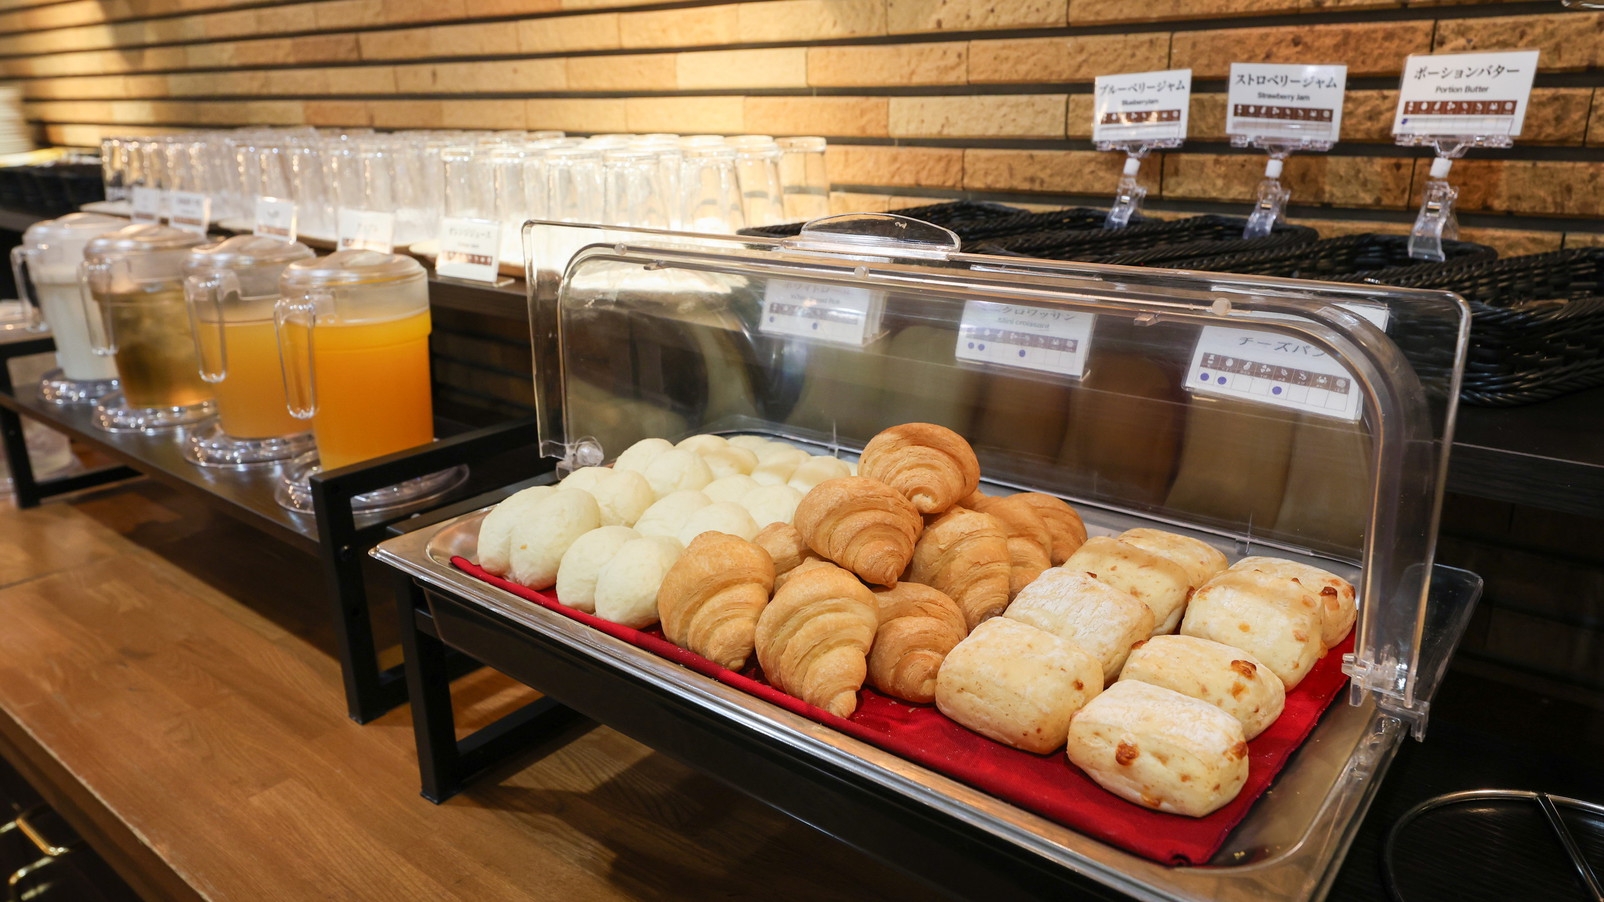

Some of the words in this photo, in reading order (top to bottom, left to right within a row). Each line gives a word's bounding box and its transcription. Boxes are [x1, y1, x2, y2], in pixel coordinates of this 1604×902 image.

[1414, 64, 1520, 80] ポーションバター
[1099, 79, 1186, 96] ブルーベリージャム
[1235, 73, 1337, 89] ストロベリージャム
[1435, 85, 1463, 94] Portion
[1464, 85, 1489, 94] Butter
